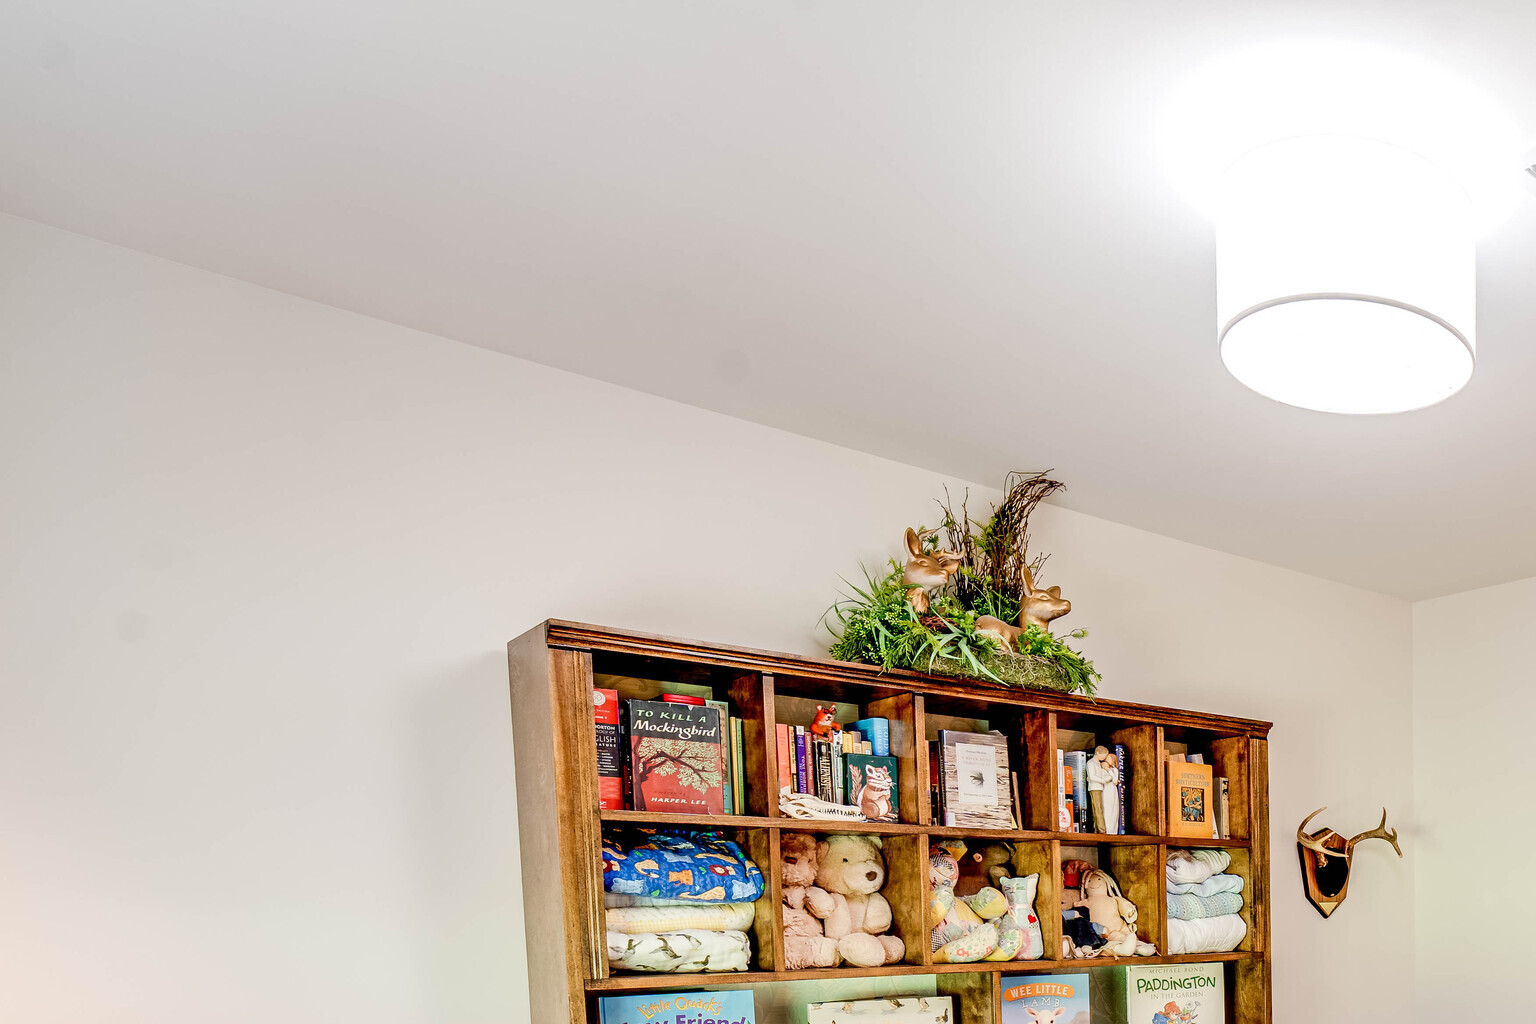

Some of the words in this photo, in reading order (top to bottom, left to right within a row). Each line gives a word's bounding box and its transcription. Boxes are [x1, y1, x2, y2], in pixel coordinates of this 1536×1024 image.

[660, 712, 693, 722] KILL
[634, 720, 716, 739] Mockingbird
[1010, 986, 1032, 998] WEE
[1036, 985, 1068, 995] LITTLE
[637, 1000, 670, 1019] Little
[674, 997, 723, 1016] Quack's
[1022, 997, 1060, 1008] LAMB
